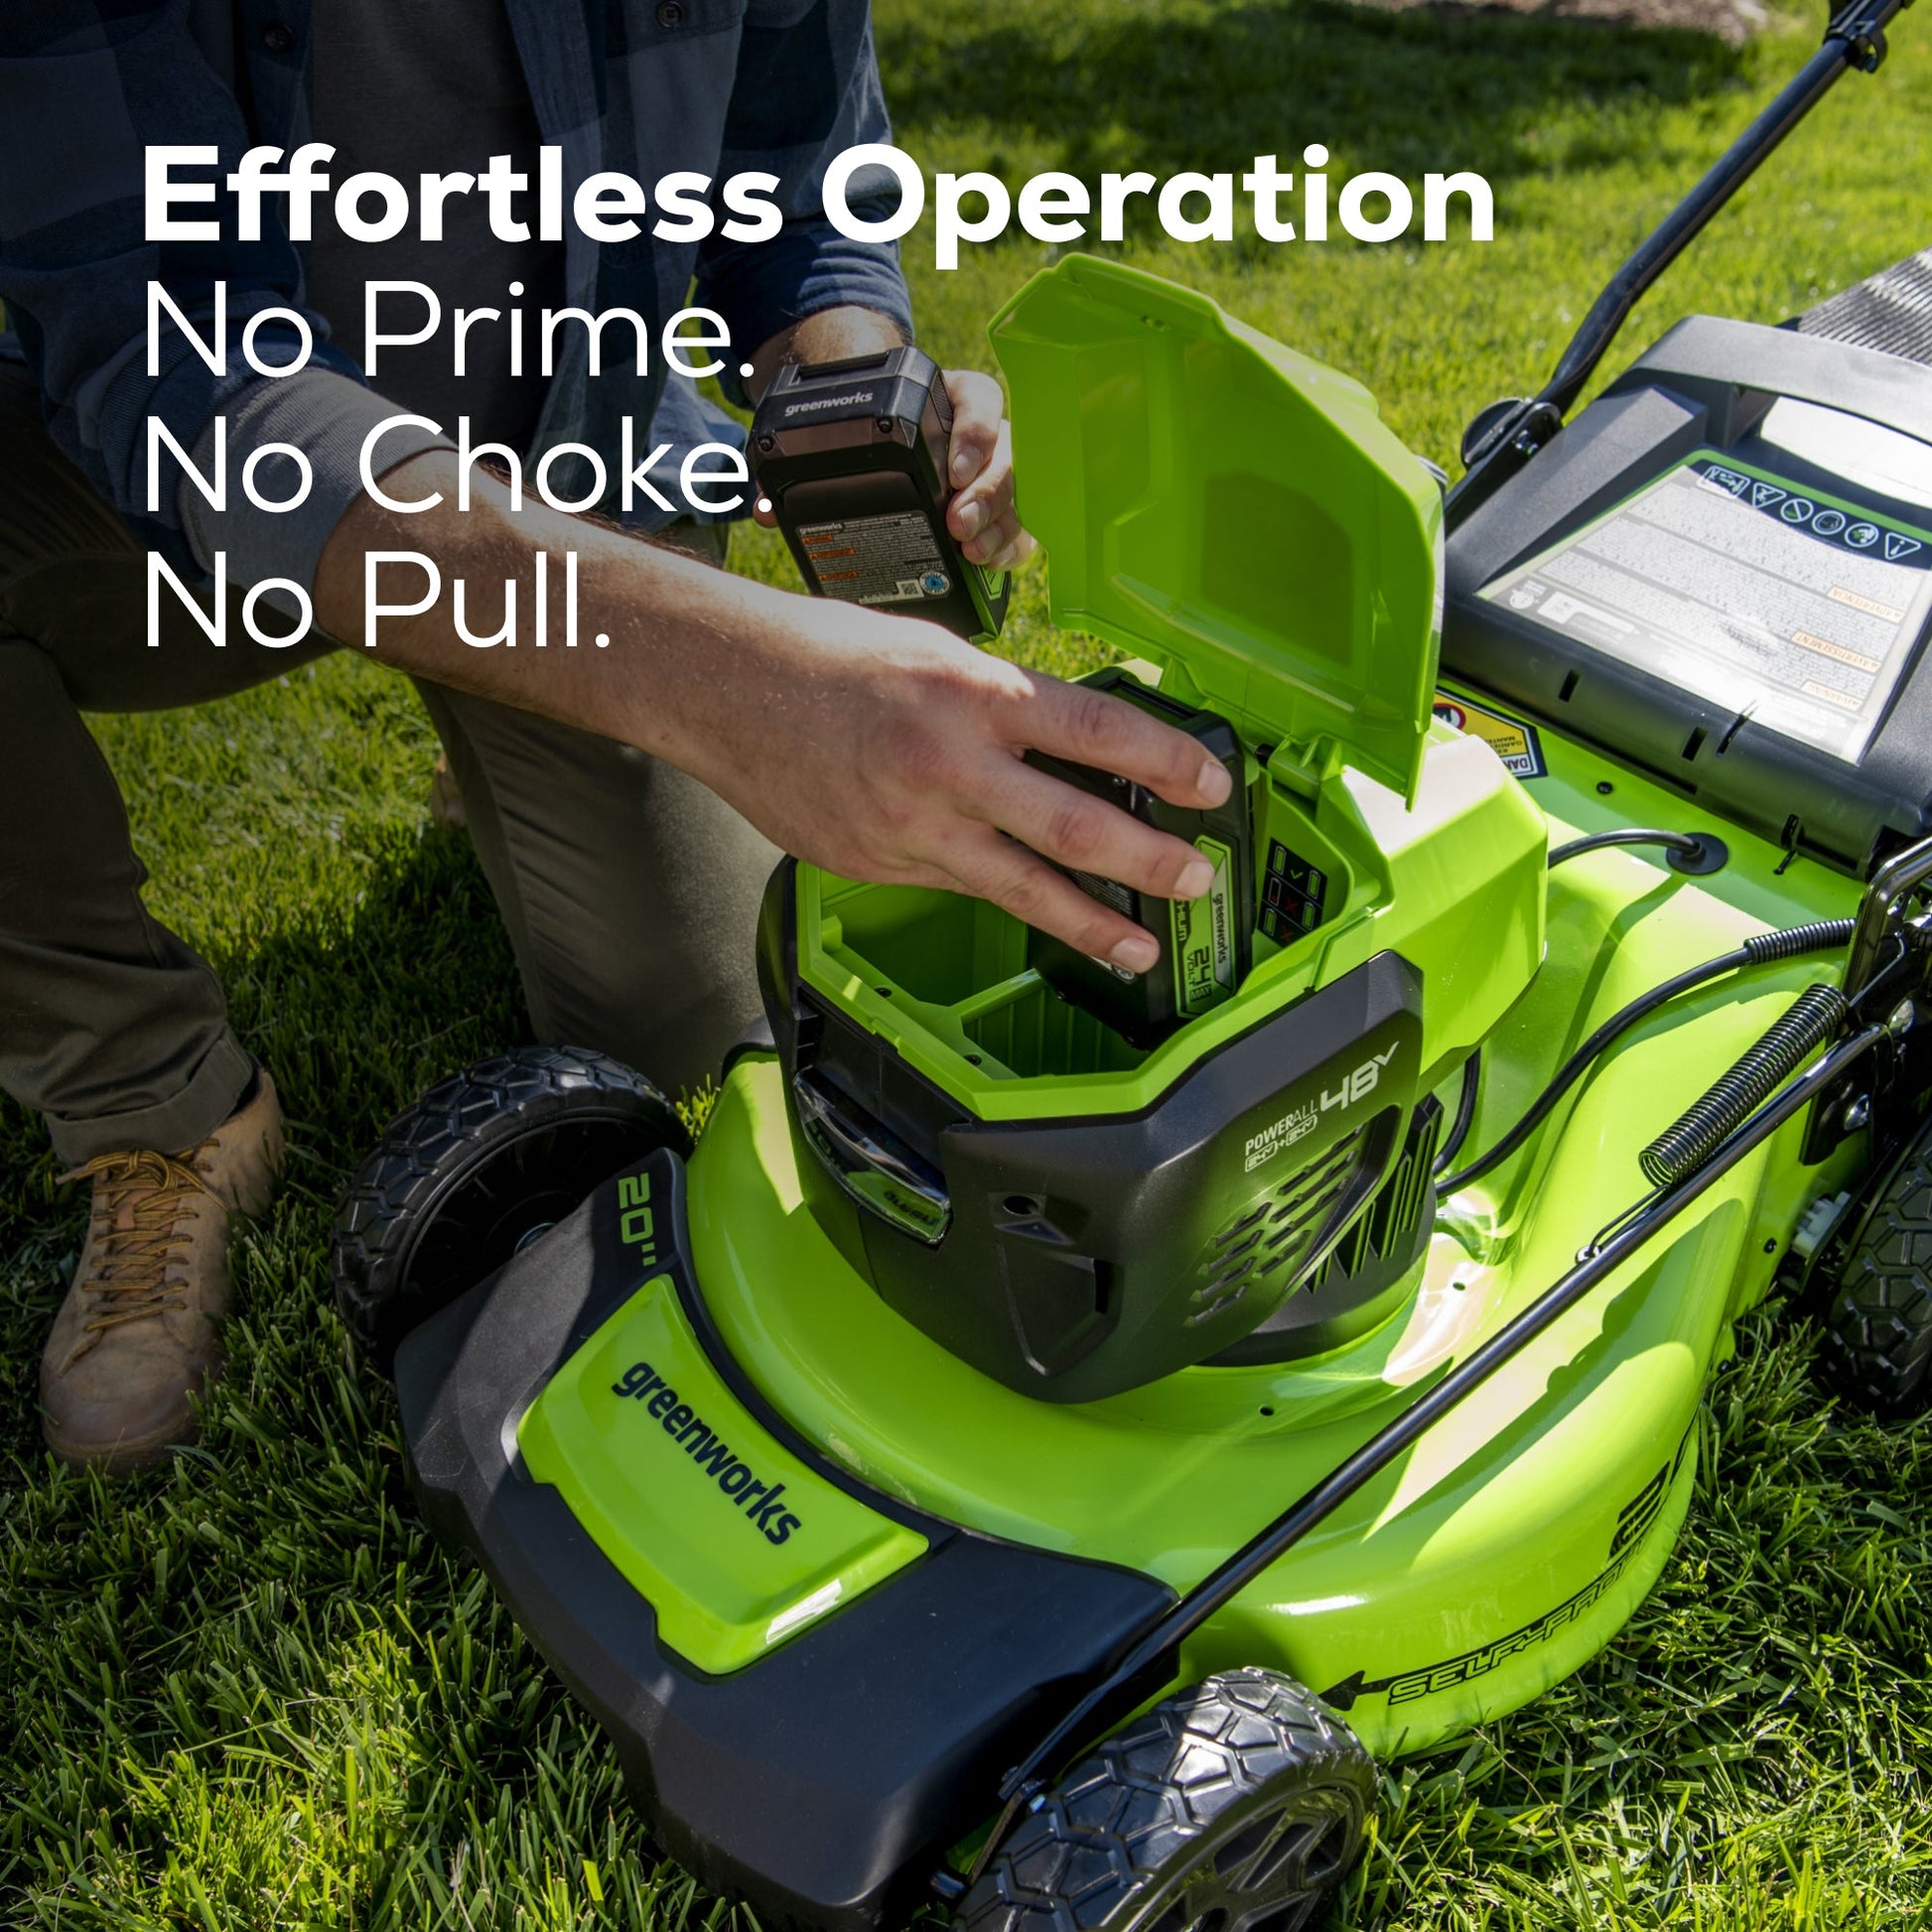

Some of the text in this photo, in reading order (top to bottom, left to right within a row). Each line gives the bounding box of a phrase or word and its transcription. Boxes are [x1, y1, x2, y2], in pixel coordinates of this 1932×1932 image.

[785, 392, 874, 417] greenworks
[1504, 758, 1528, 770] DAN
[1212, 893, 1229, 964] greenworks
[1186, 952, 1196, 986] VOLT
[1193, 945, 1211, 985] 24
[1245, 1040, 1399, 1157] POWERALL 48V
[611, 1361, 802, 1546] greenworks
